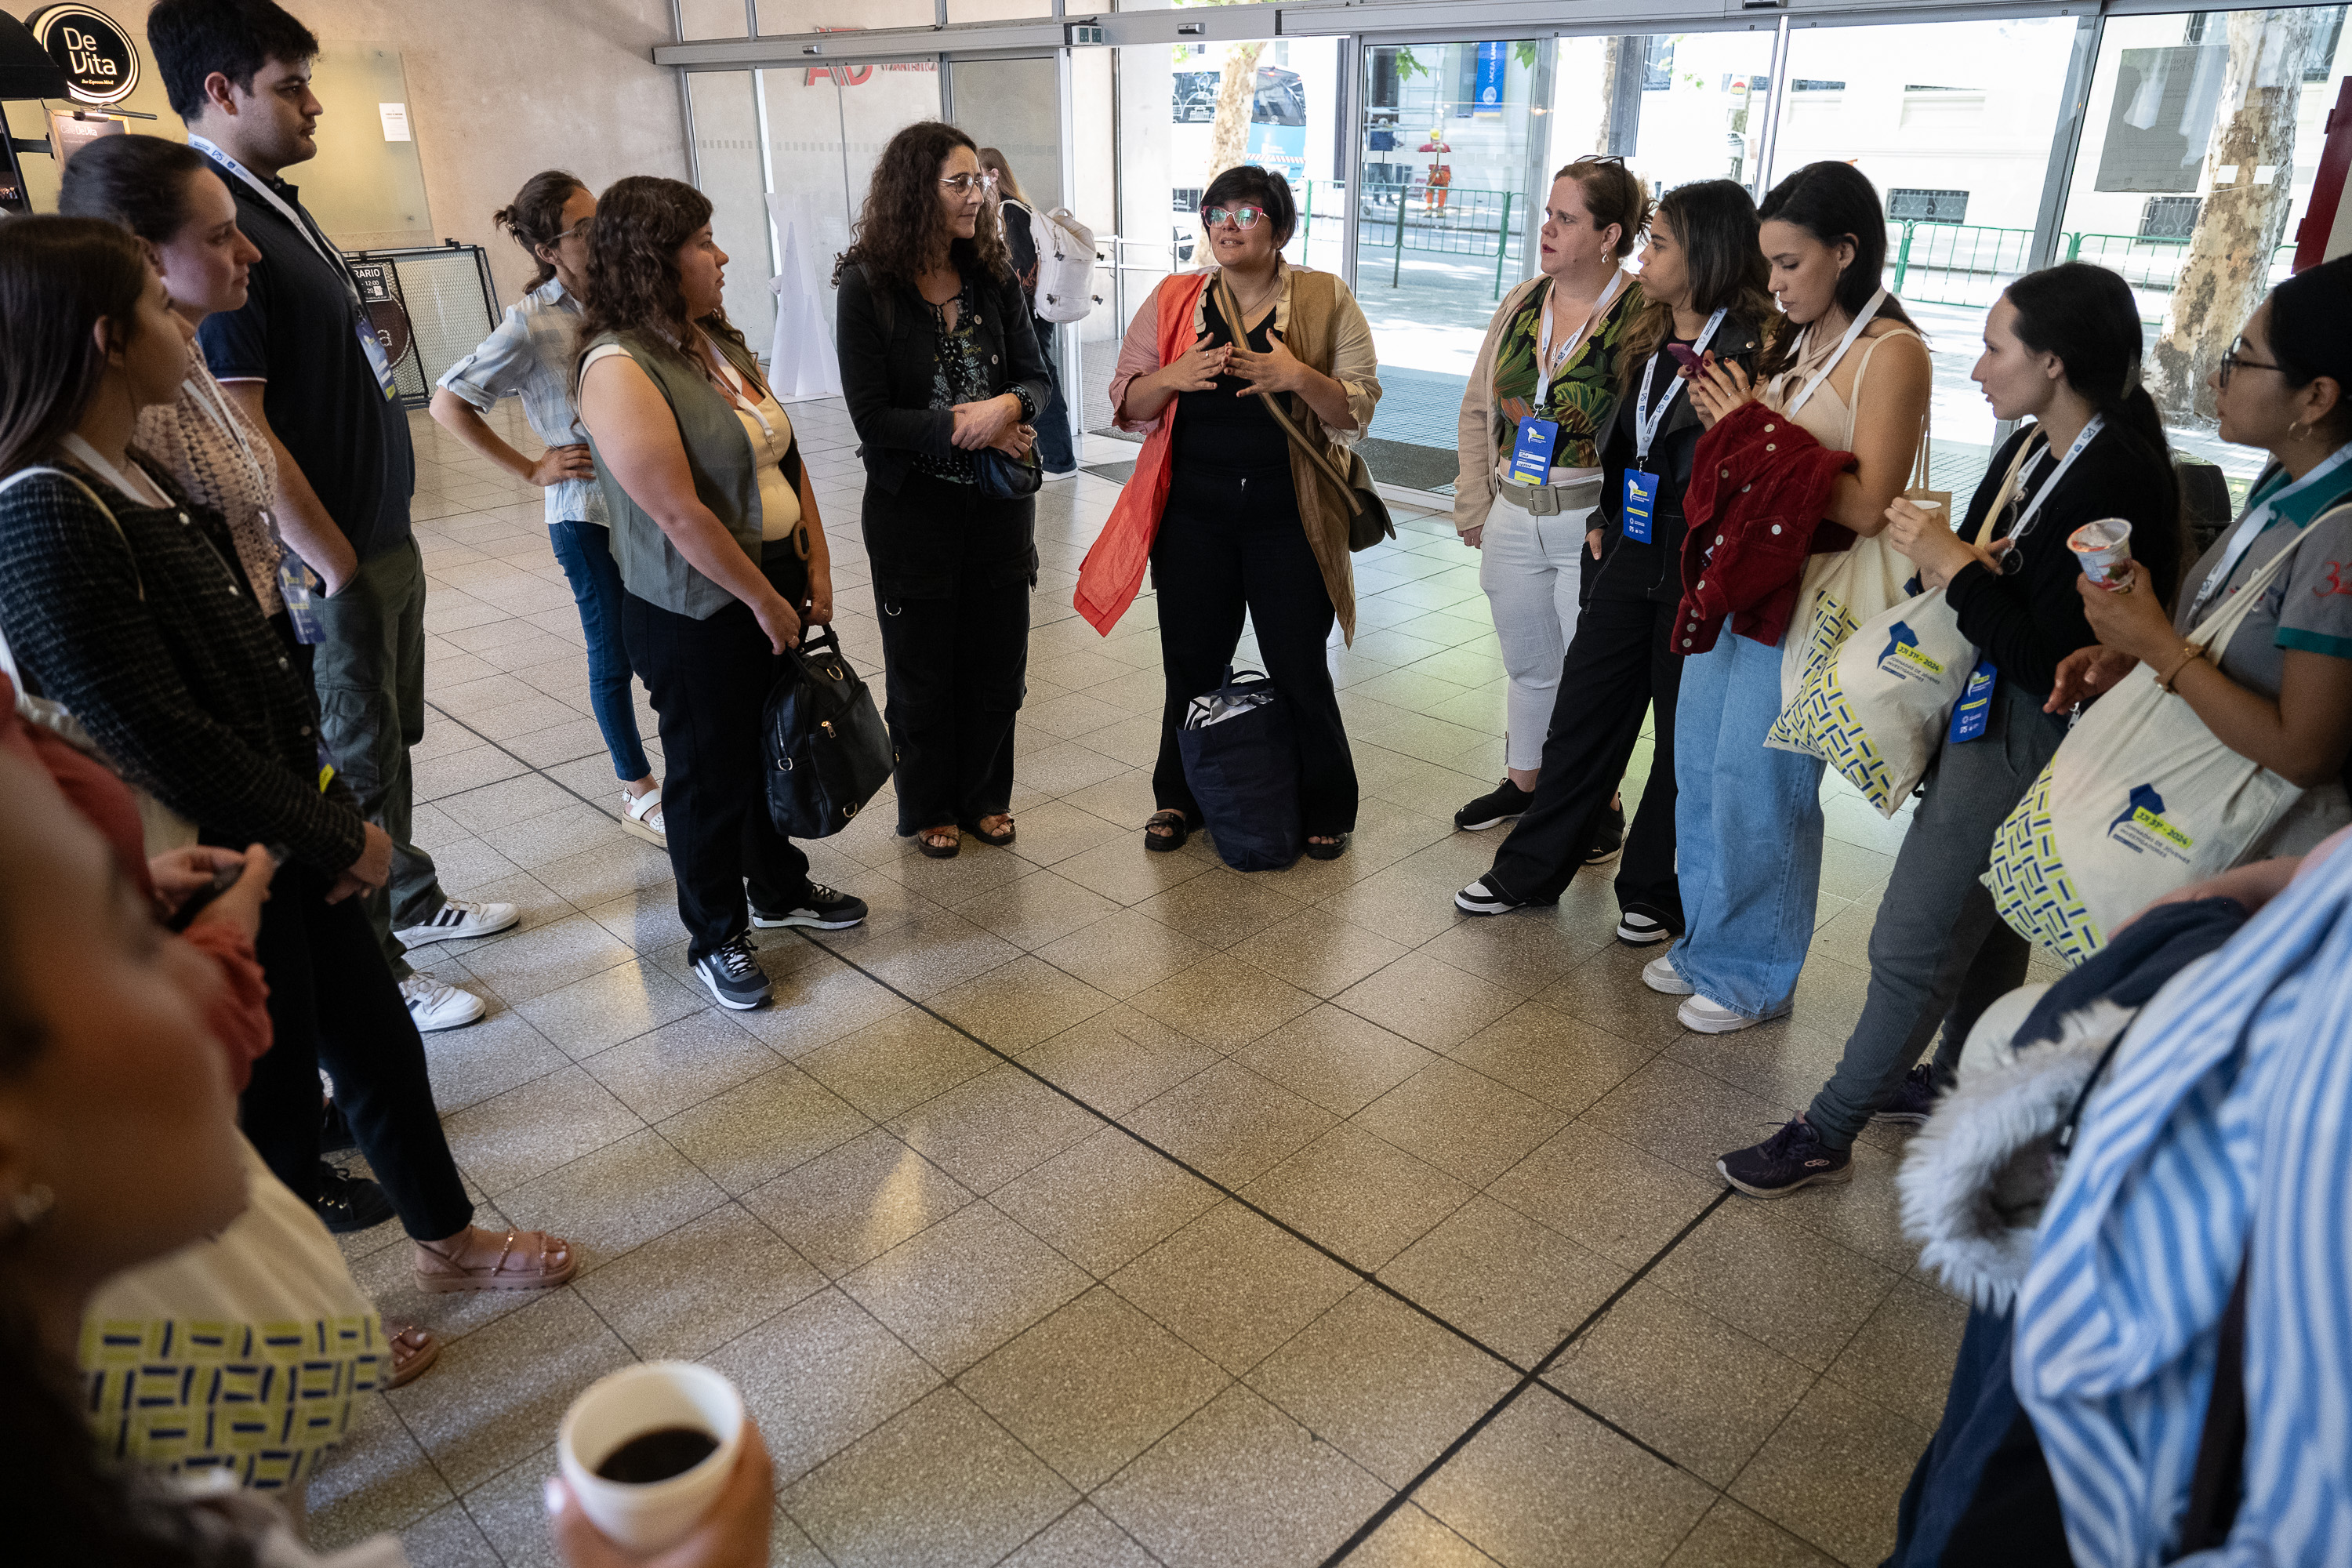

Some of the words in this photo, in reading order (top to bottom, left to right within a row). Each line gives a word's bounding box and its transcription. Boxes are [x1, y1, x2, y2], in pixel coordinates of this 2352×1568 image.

[63, 27, 97, 51] De
[69, 51, 118, 75] Vita
[1890, 657, 1914, 670] JORNADAS
[1898, 646, 1909, 655] JJI
[1923, 659, 1940, 671] 2024
[1887, 661, 1924, 682] INVESTIGADORES
[2166, 829, 2188, 845] 2024
